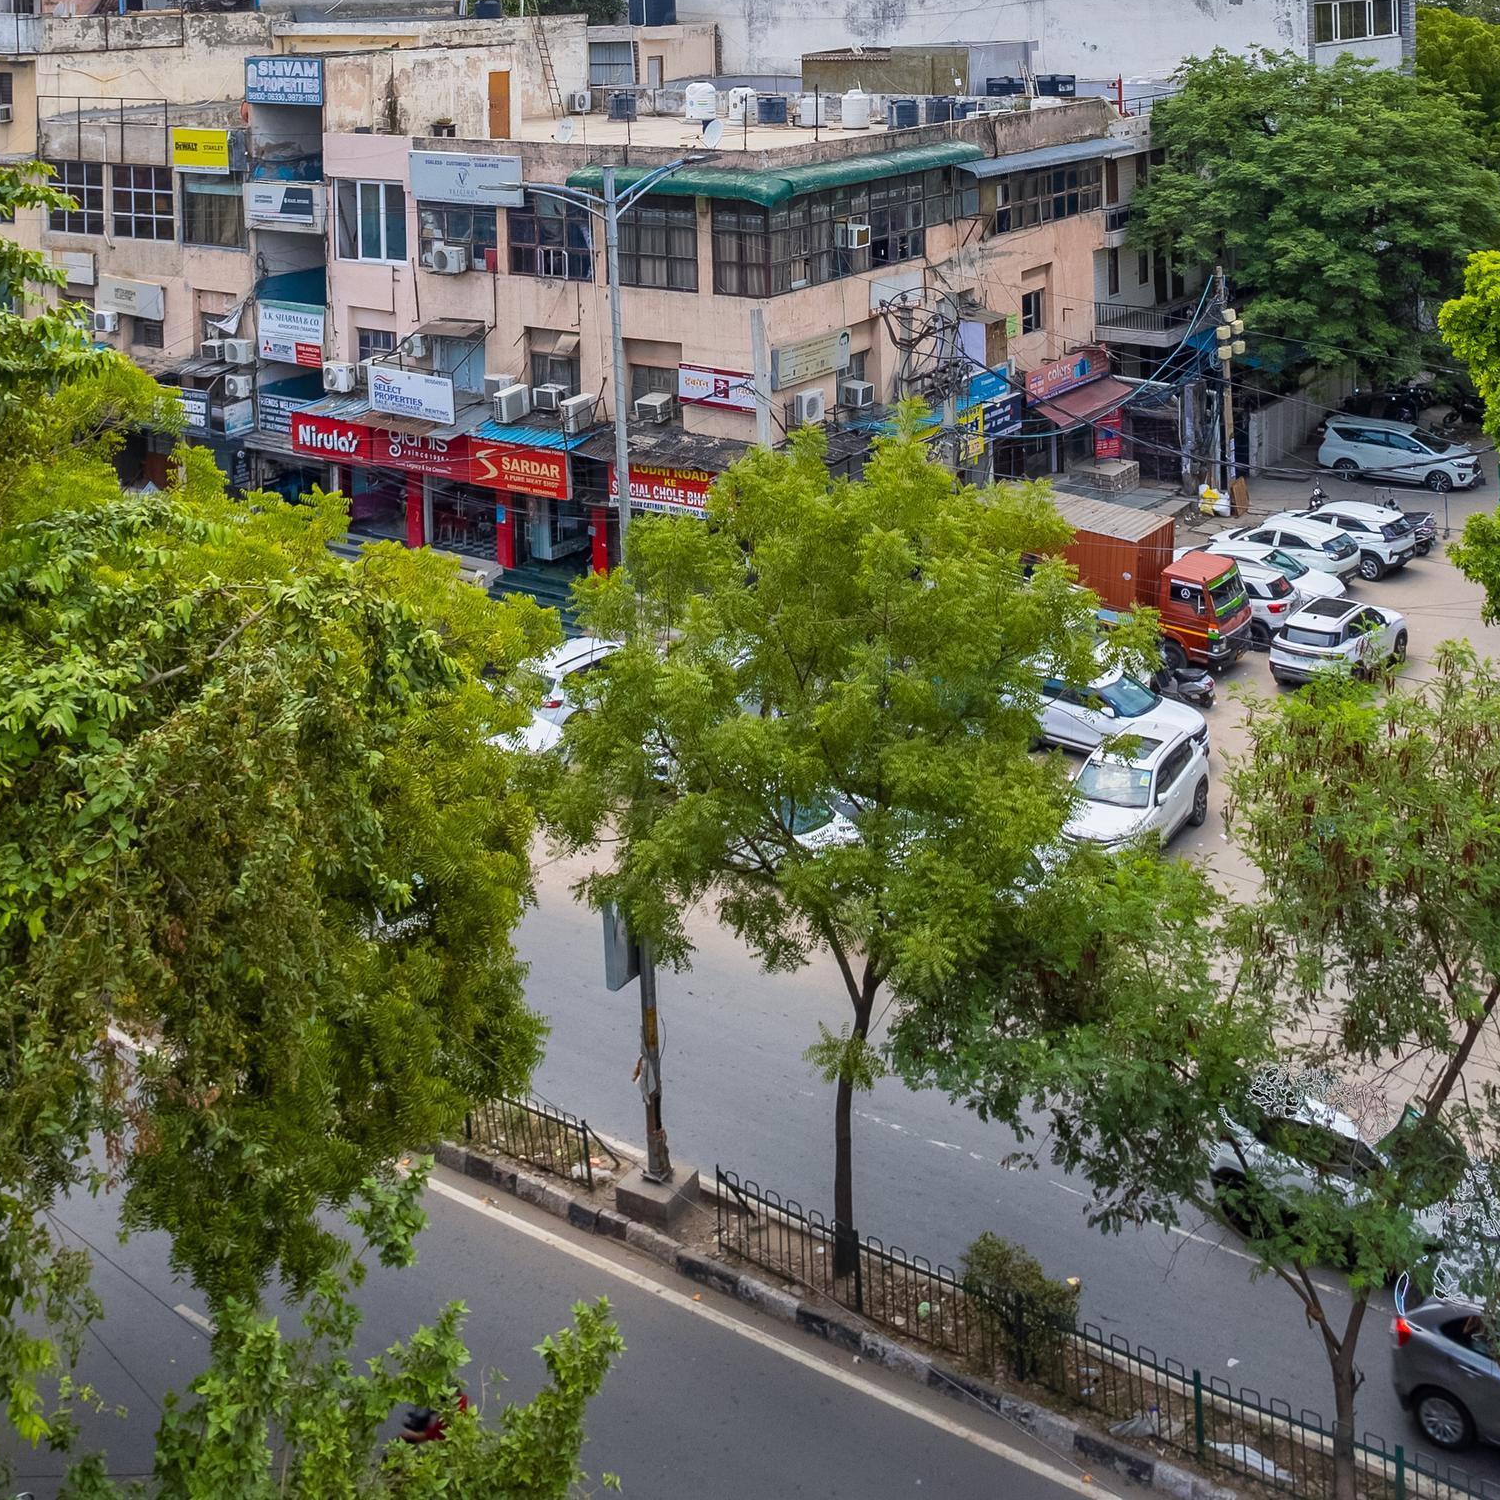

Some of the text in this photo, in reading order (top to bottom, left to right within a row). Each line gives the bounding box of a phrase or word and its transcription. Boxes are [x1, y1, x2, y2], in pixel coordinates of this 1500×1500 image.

[258, 60, 318, 77] SHIVAM
[257, 76, 319, 93] PROPERTIES
[275, 313, 303, 324] SHARMA
[373, 382, 402, 395] SELECT
[374, 391, 423, 407] PROPERTIES
[392, 402, 420, 411] PURCHASE
[425, 408, 450, 417] RENTING
[298, 424, 359, 453] Nirula's
[501, 456, 560, 479] SARDAR
[633, 464, 709, 483] LODHI ROAD
[509, 475, 526, 483] PURE
[525, 478, 542, 486] MEAT
[543, 480, 559, 488] SHOP
[664, 478, 677, 487] KE
[612, 480, 651, 498] SCIAL
[653, 485, 685, 503] CHOLE
